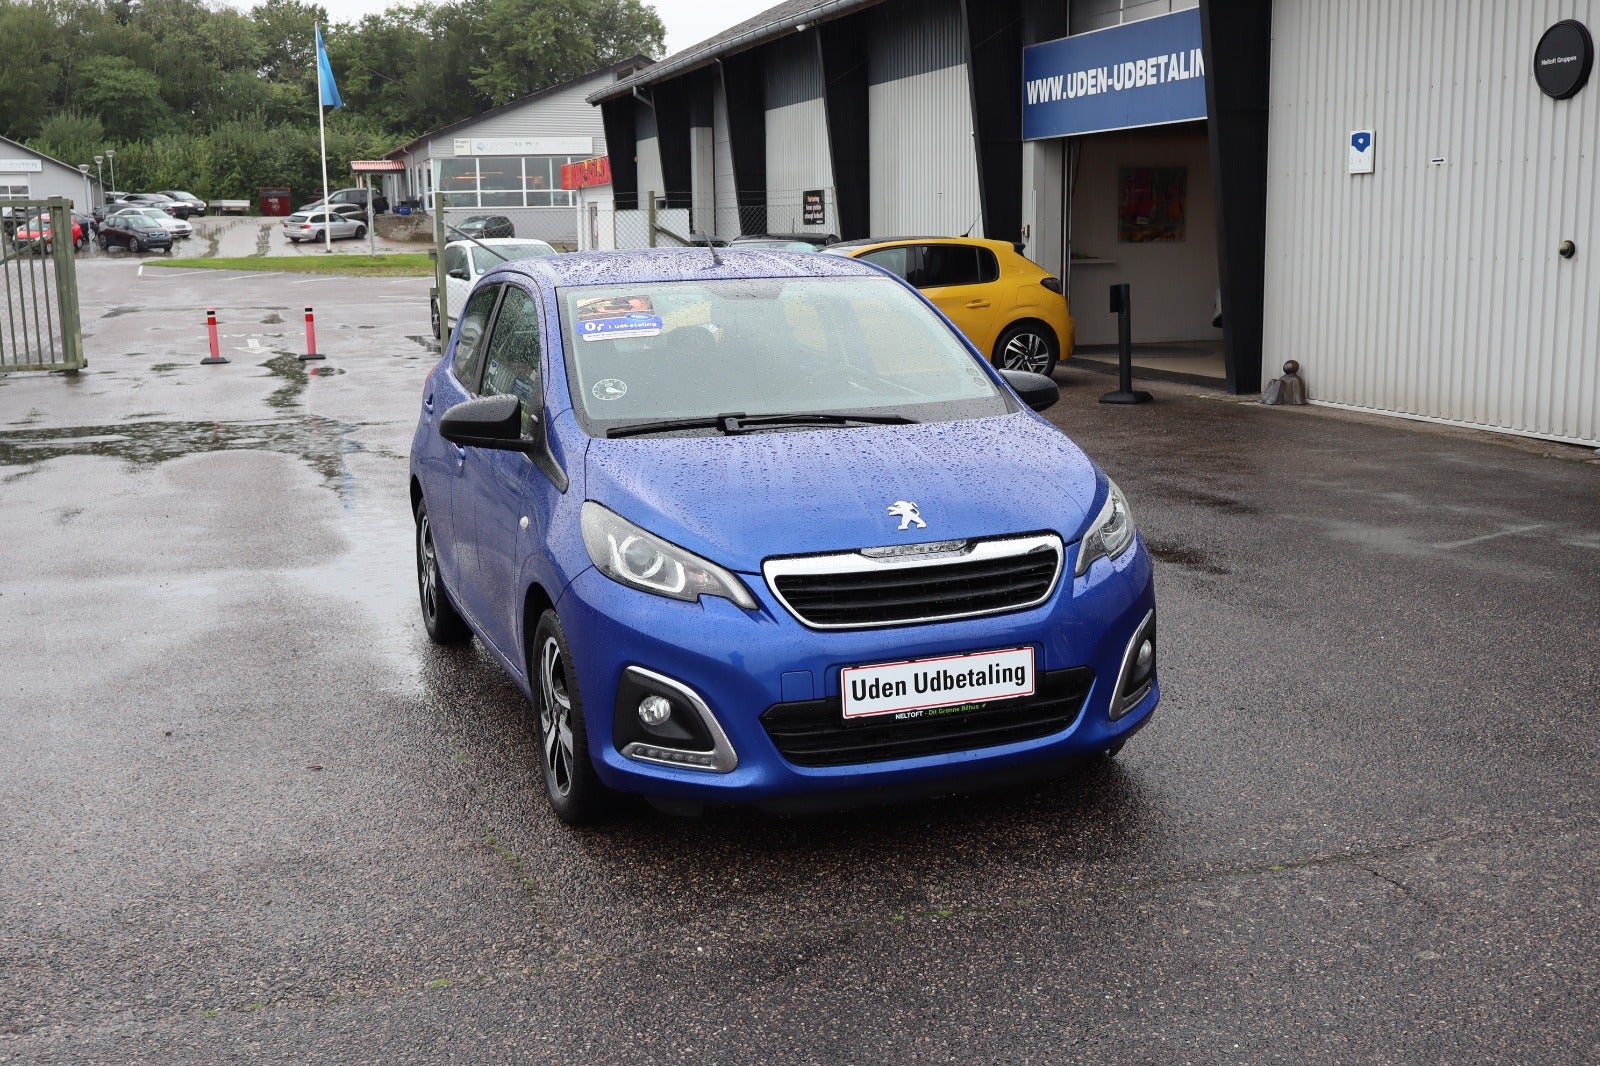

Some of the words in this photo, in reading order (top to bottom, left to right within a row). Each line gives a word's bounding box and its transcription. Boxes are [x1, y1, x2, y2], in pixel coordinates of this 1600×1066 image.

[851, 678, 907, 701] Uden
[913, 663, 1026, 694] Udbetaling
[895, 711, 924, 720] NELTOFT
